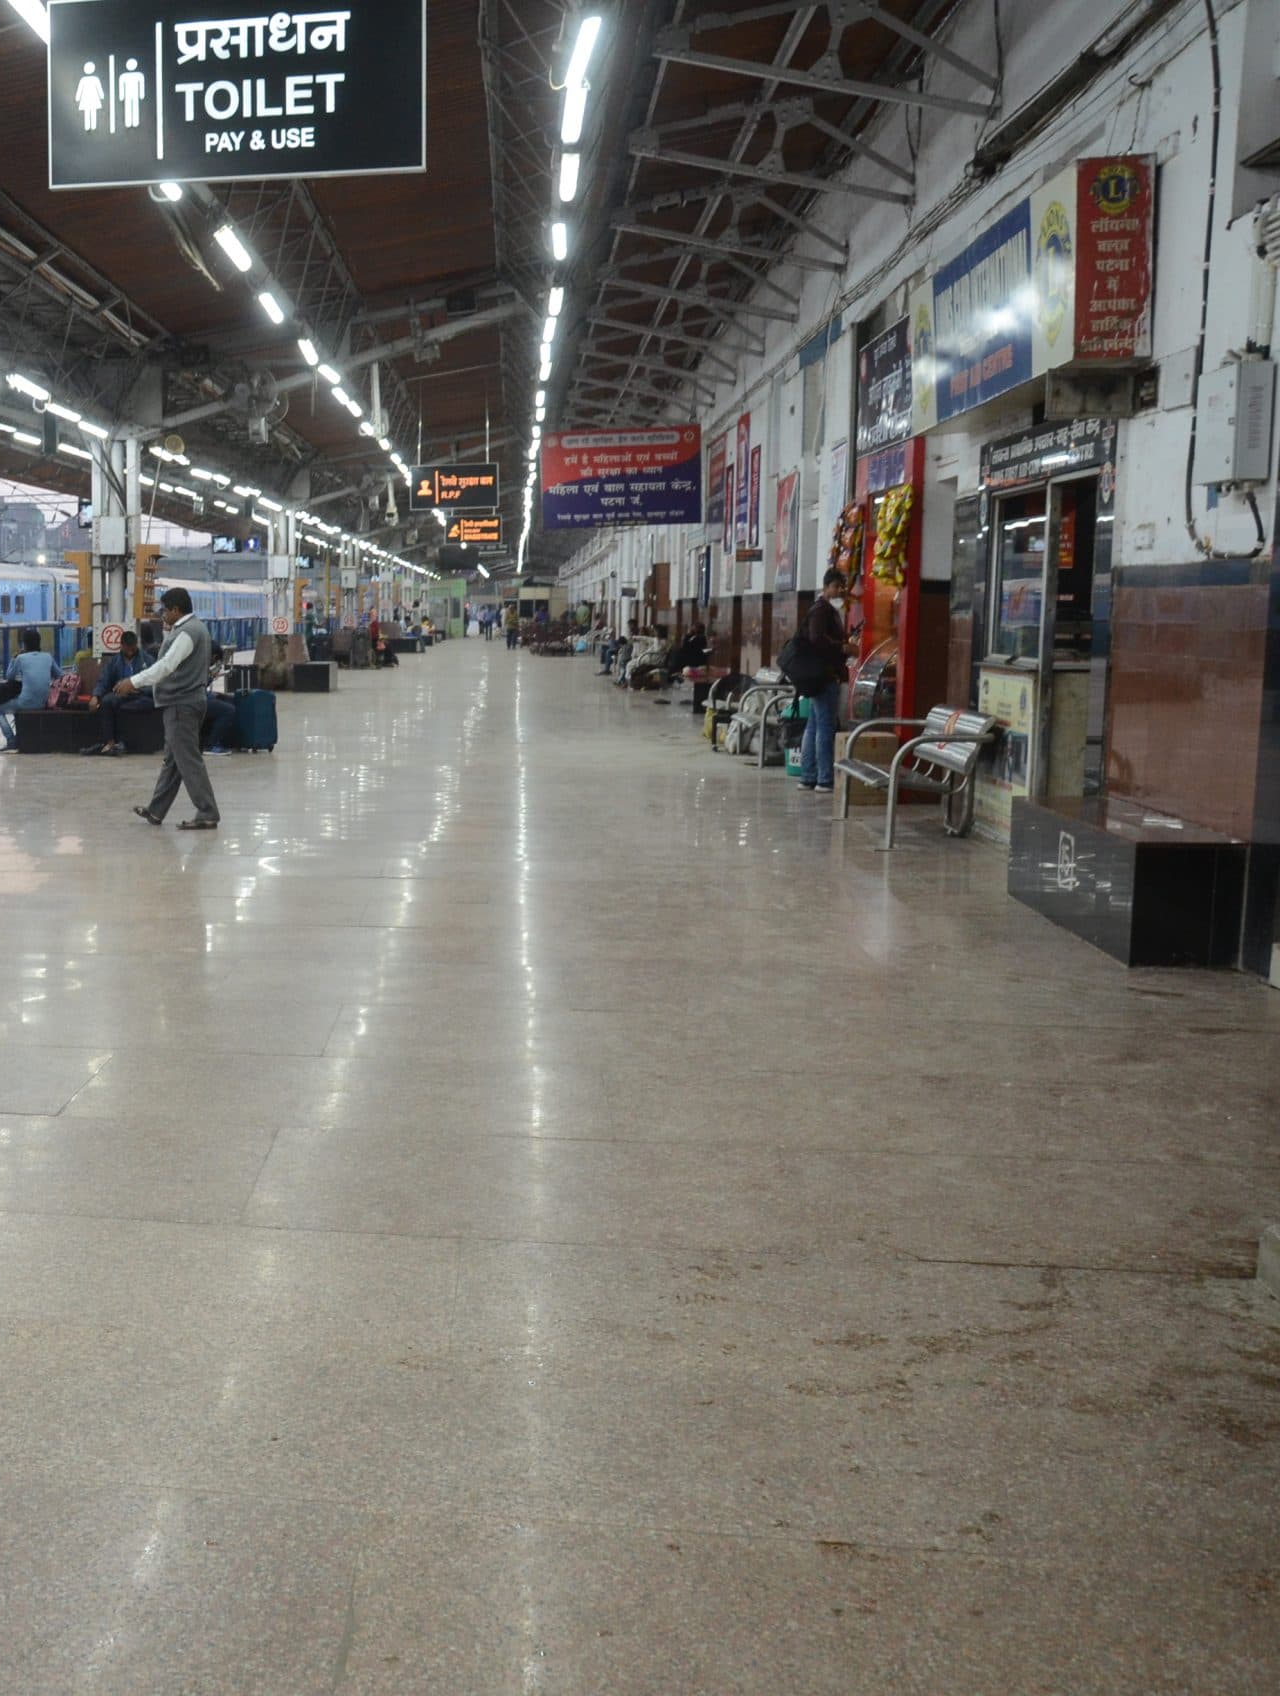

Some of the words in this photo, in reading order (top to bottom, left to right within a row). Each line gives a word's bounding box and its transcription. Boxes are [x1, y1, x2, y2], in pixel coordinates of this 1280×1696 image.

[174, 11, 351, 65] प्रसाधन
[175, 73, 345, 121] TOILET
[205, 130, 245, 153] PAY
[250, 129, 265, 150] &
[271, 127, 315, 149] USE
[105, 629, 122, 644] 22
